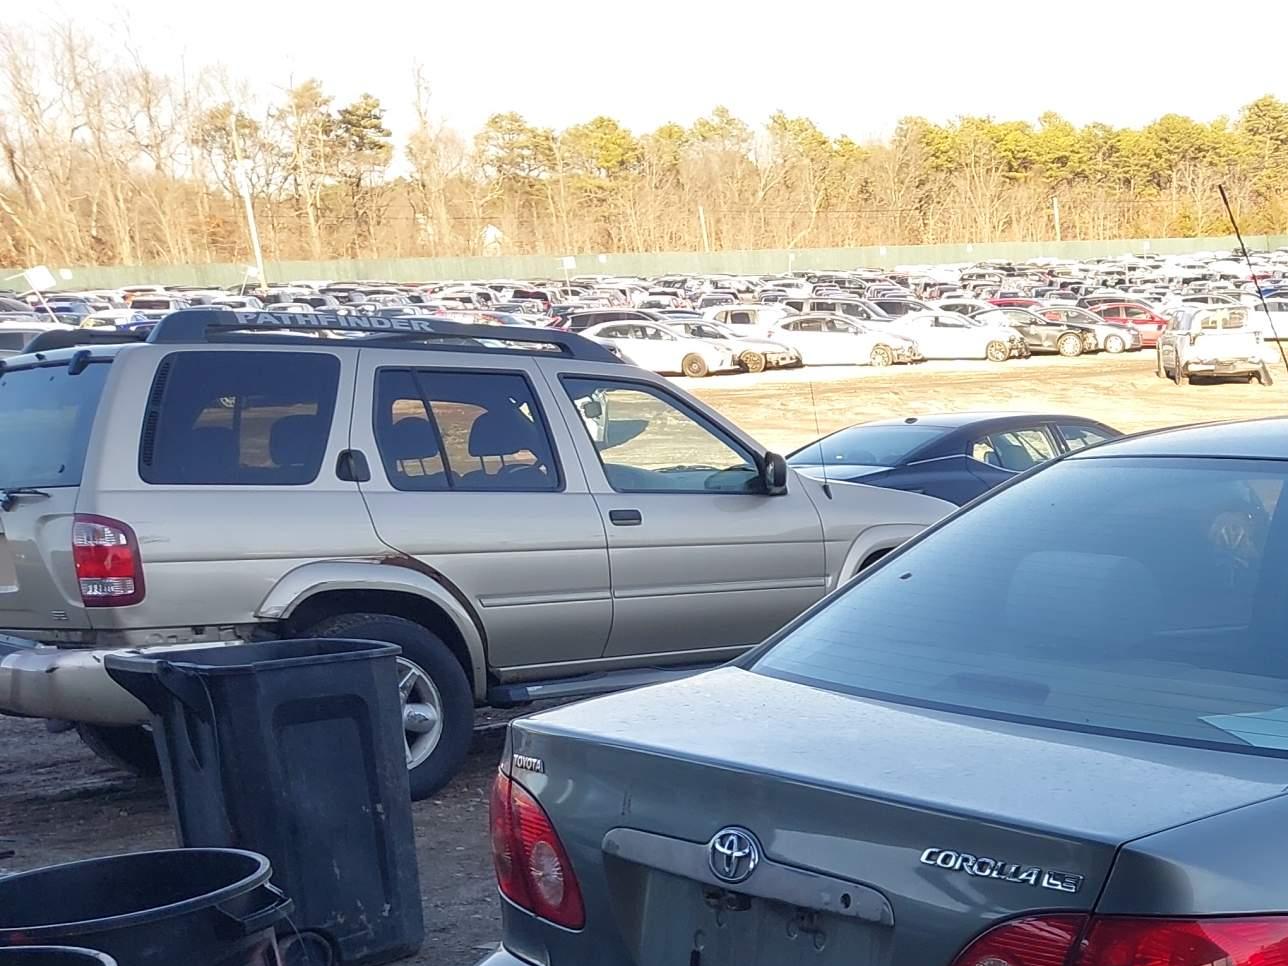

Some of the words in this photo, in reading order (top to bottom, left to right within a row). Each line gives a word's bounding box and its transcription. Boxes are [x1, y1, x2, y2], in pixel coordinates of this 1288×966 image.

[234, 311, 434, 332] PATHFINDER
[513, 753, 544, 773] TOYOTA
[920, 848, 1041, 886] COROLLA
[1042, 871, 1083, 893] LE
